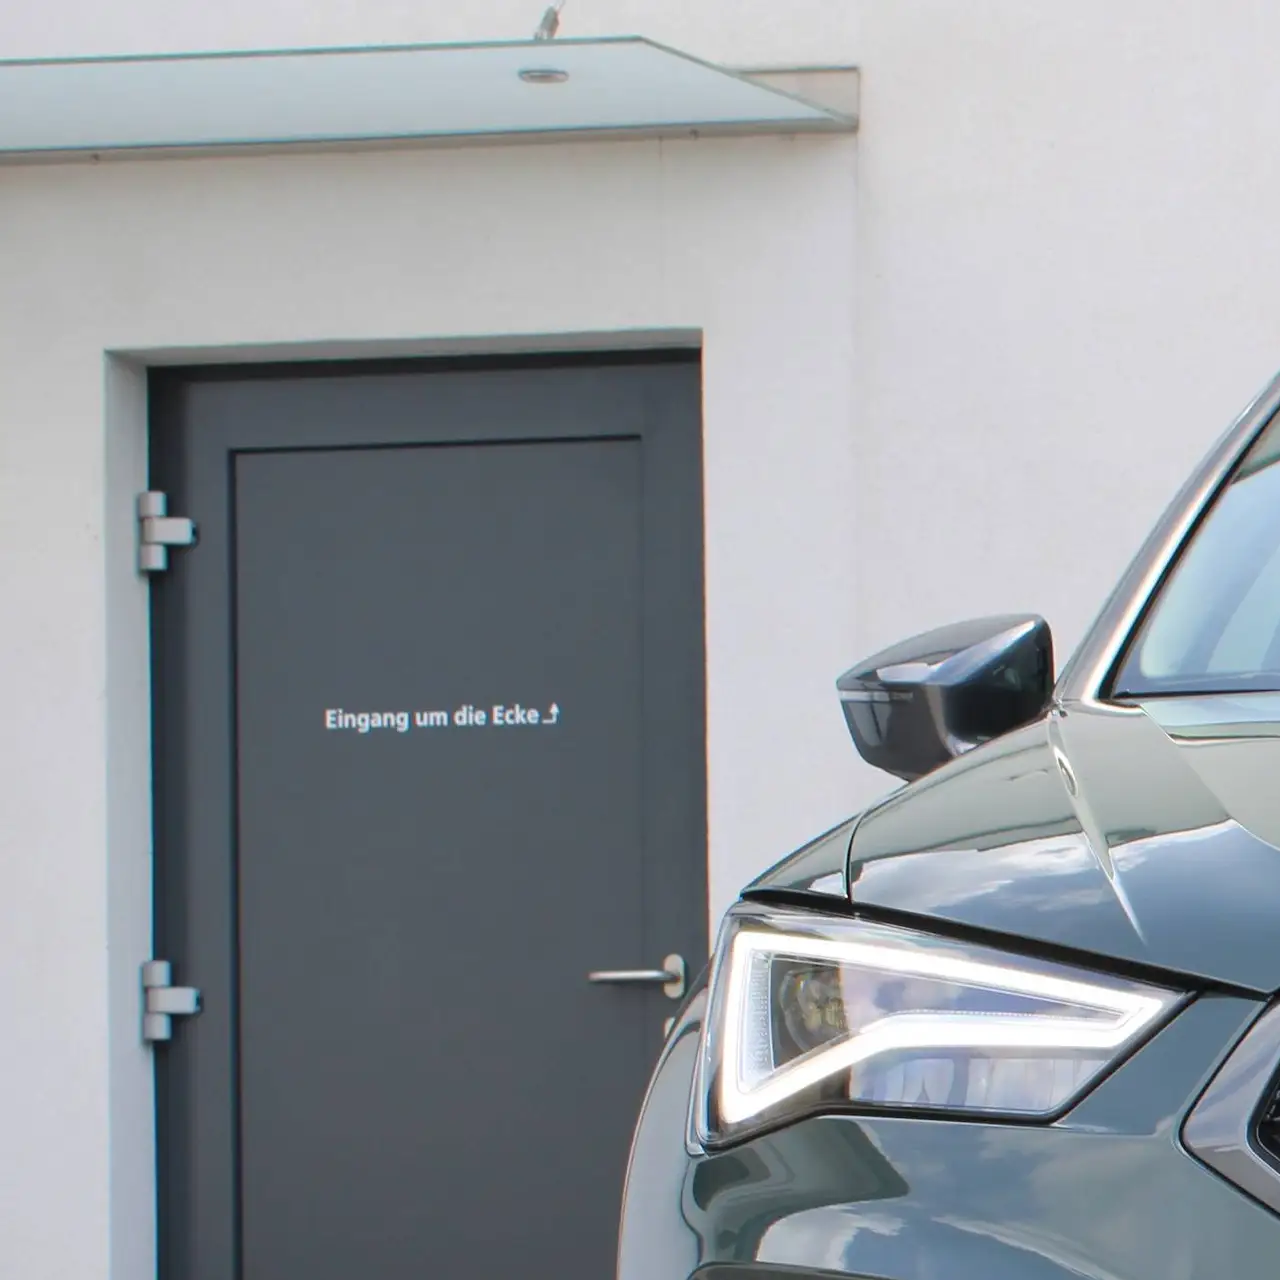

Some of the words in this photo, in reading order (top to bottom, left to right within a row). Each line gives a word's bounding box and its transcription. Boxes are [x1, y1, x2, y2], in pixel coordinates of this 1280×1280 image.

[325, 709, 409, 733] Eingang
[415, 711, 448, 727] um
[453, 704, 486, 726] die
[492, 703, 540, 725] Ecke
